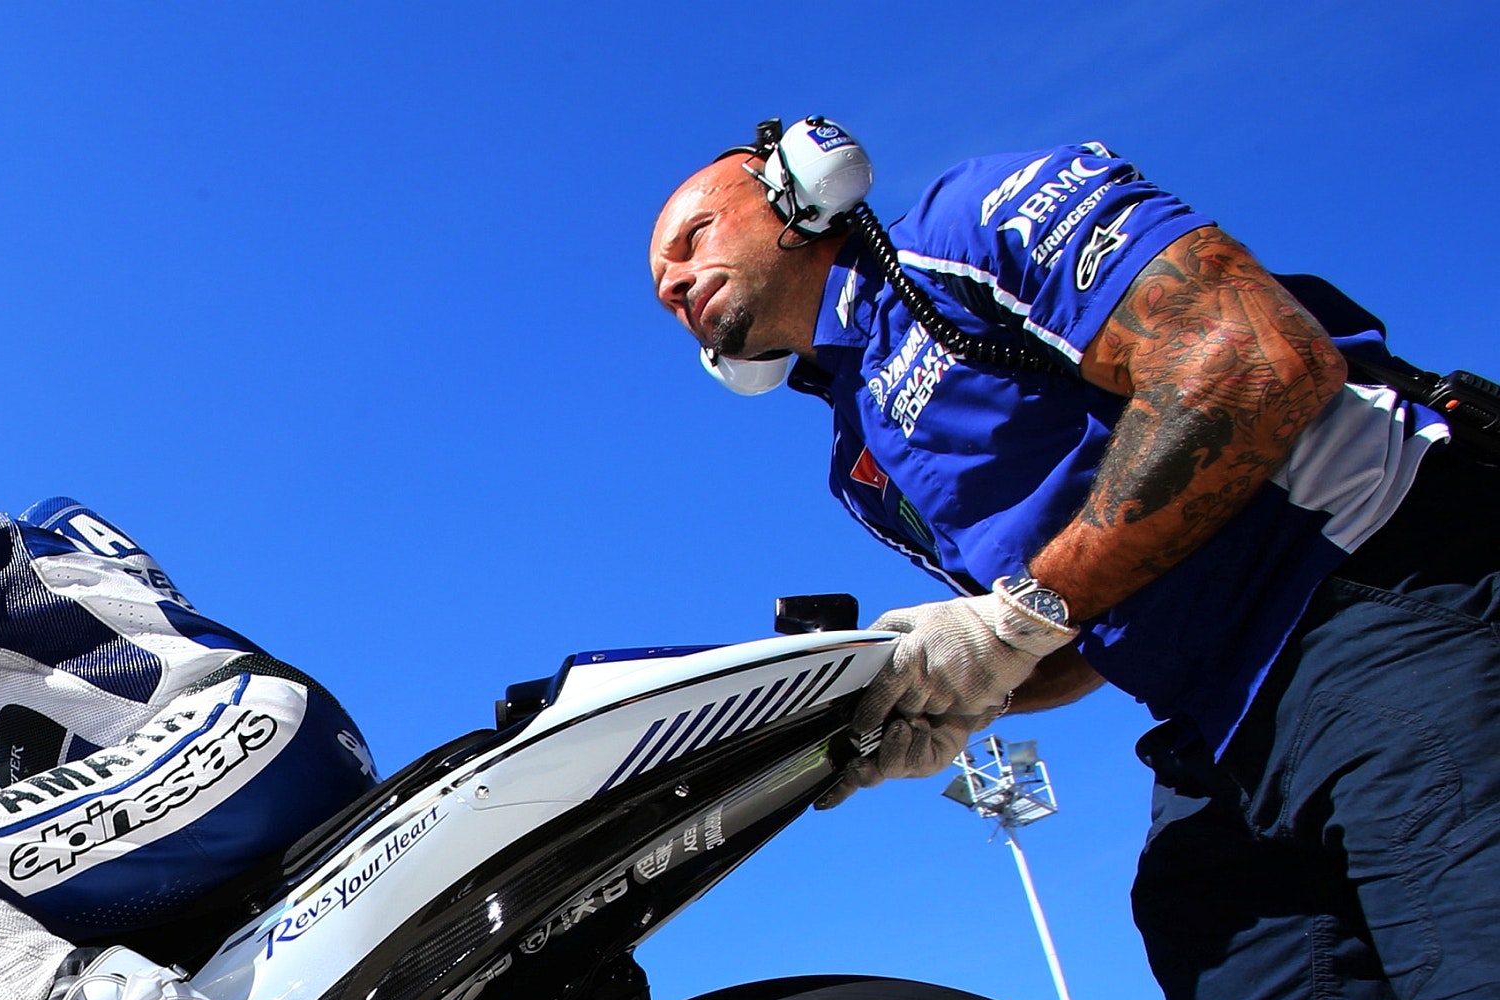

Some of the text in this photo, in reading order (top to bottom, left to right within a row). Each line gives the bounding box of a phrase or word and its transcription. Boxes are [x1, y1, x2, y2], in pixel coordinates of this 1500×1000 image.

[1014, 157, 1109, 222] BMC
[879, 321, 929, 388] YAMA
[9, 709, 278, 881] alpinestars
[255, 804, 440, 961] Revs Your Heart
